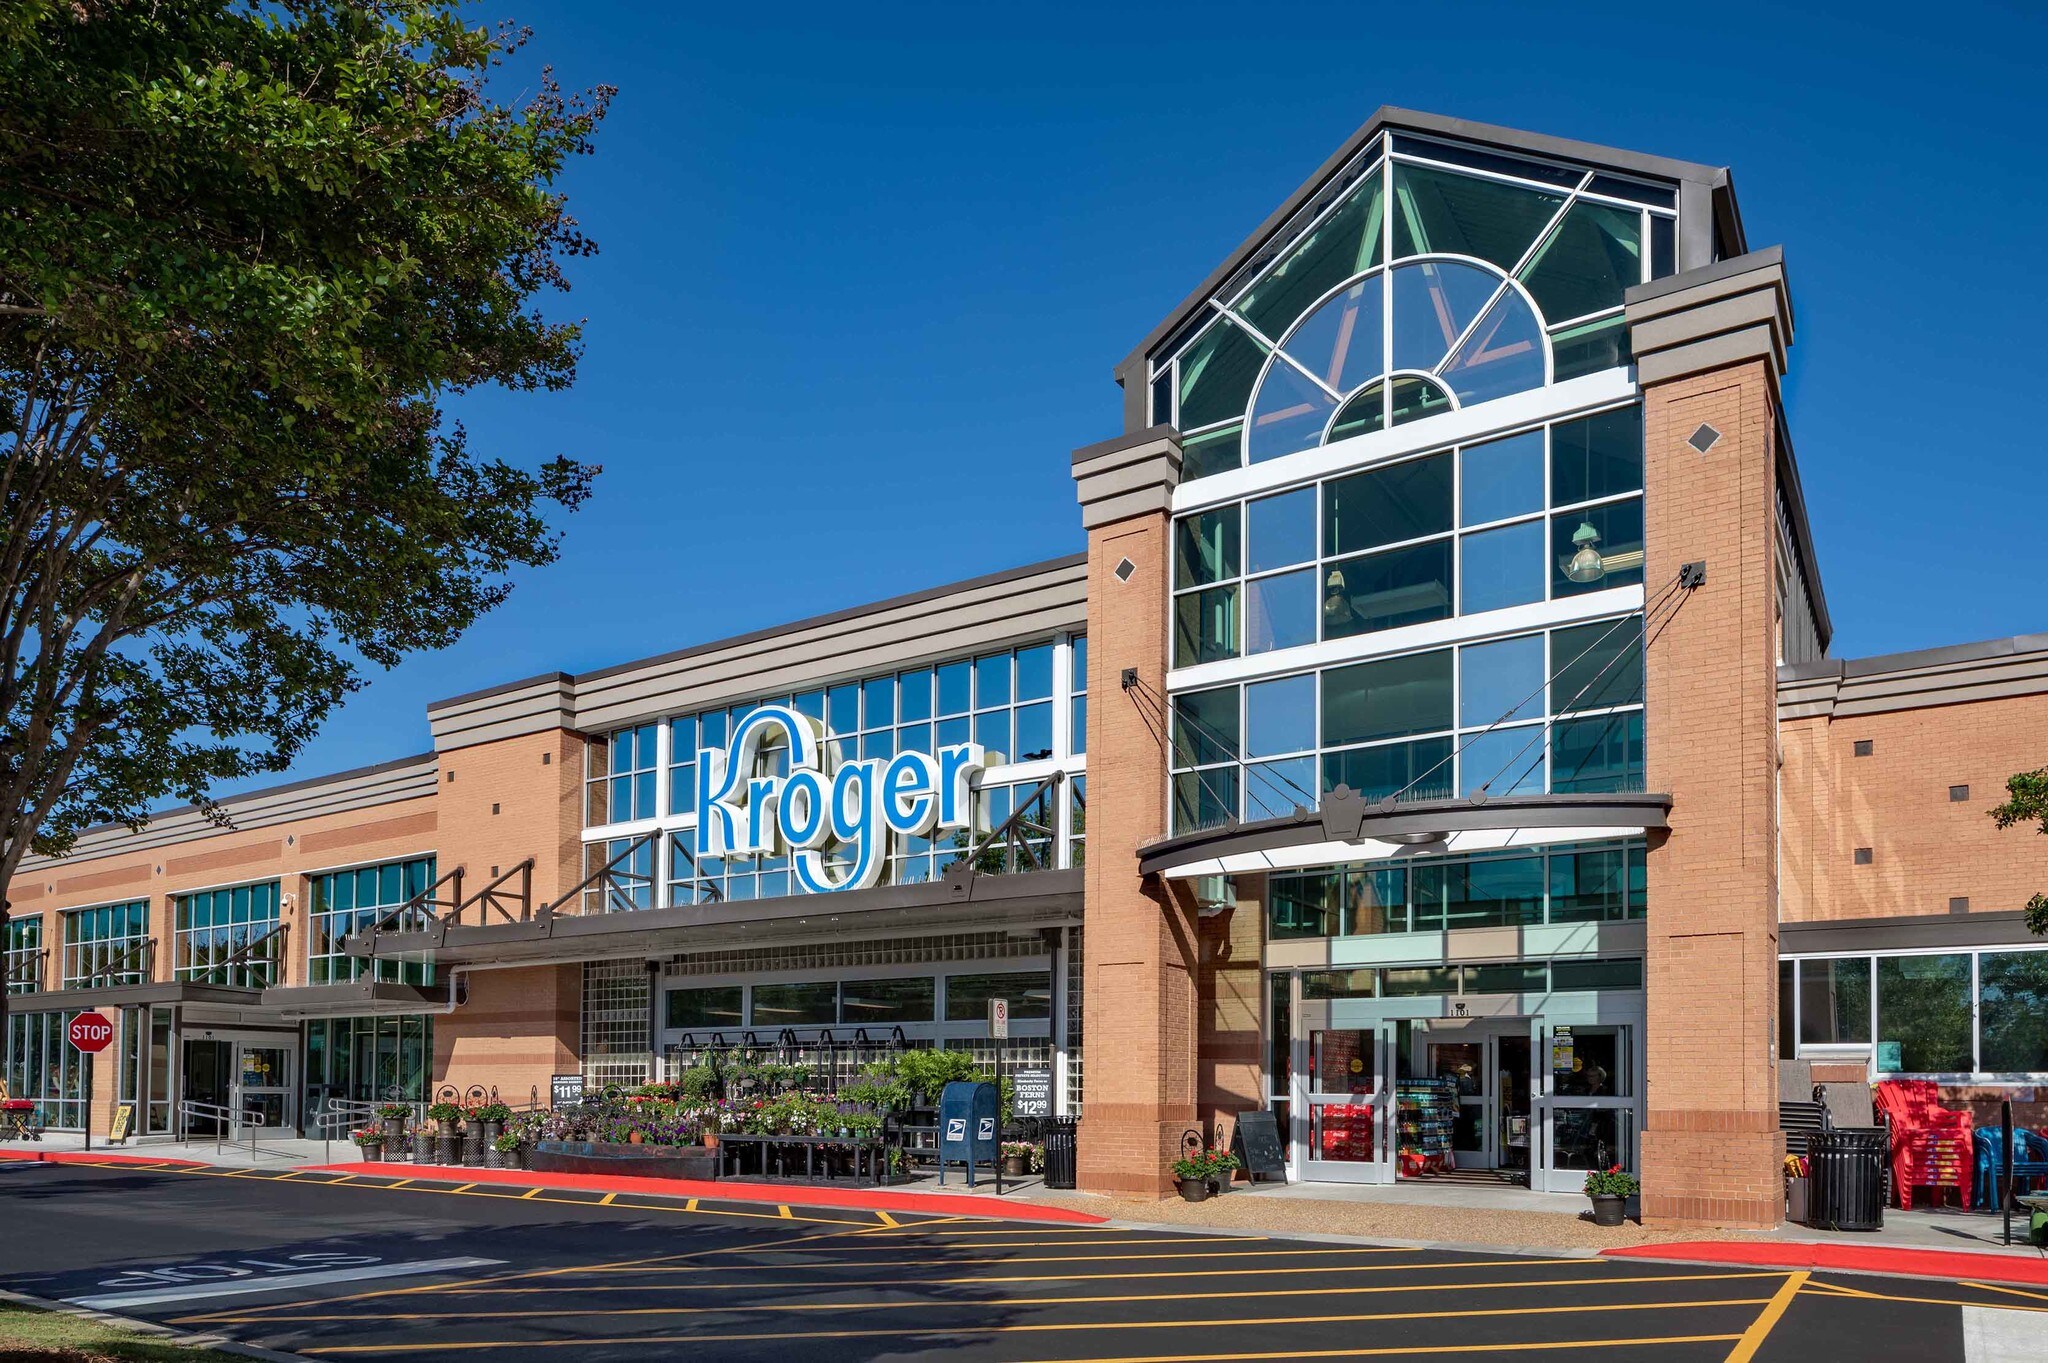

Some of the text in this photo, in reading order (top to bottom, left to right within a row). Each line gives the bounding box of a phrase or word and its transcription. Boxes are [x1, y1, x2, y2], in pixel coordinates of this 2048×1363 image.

[697, 705, 984, 894] Kroger
[1450, 1009, 1469, 1017] 1101
[72, 1025, 111, 1041] STOP
[1016, 1084, 1049, 1092] BOSTON
[98, 1252, 382, 1288] STOP
